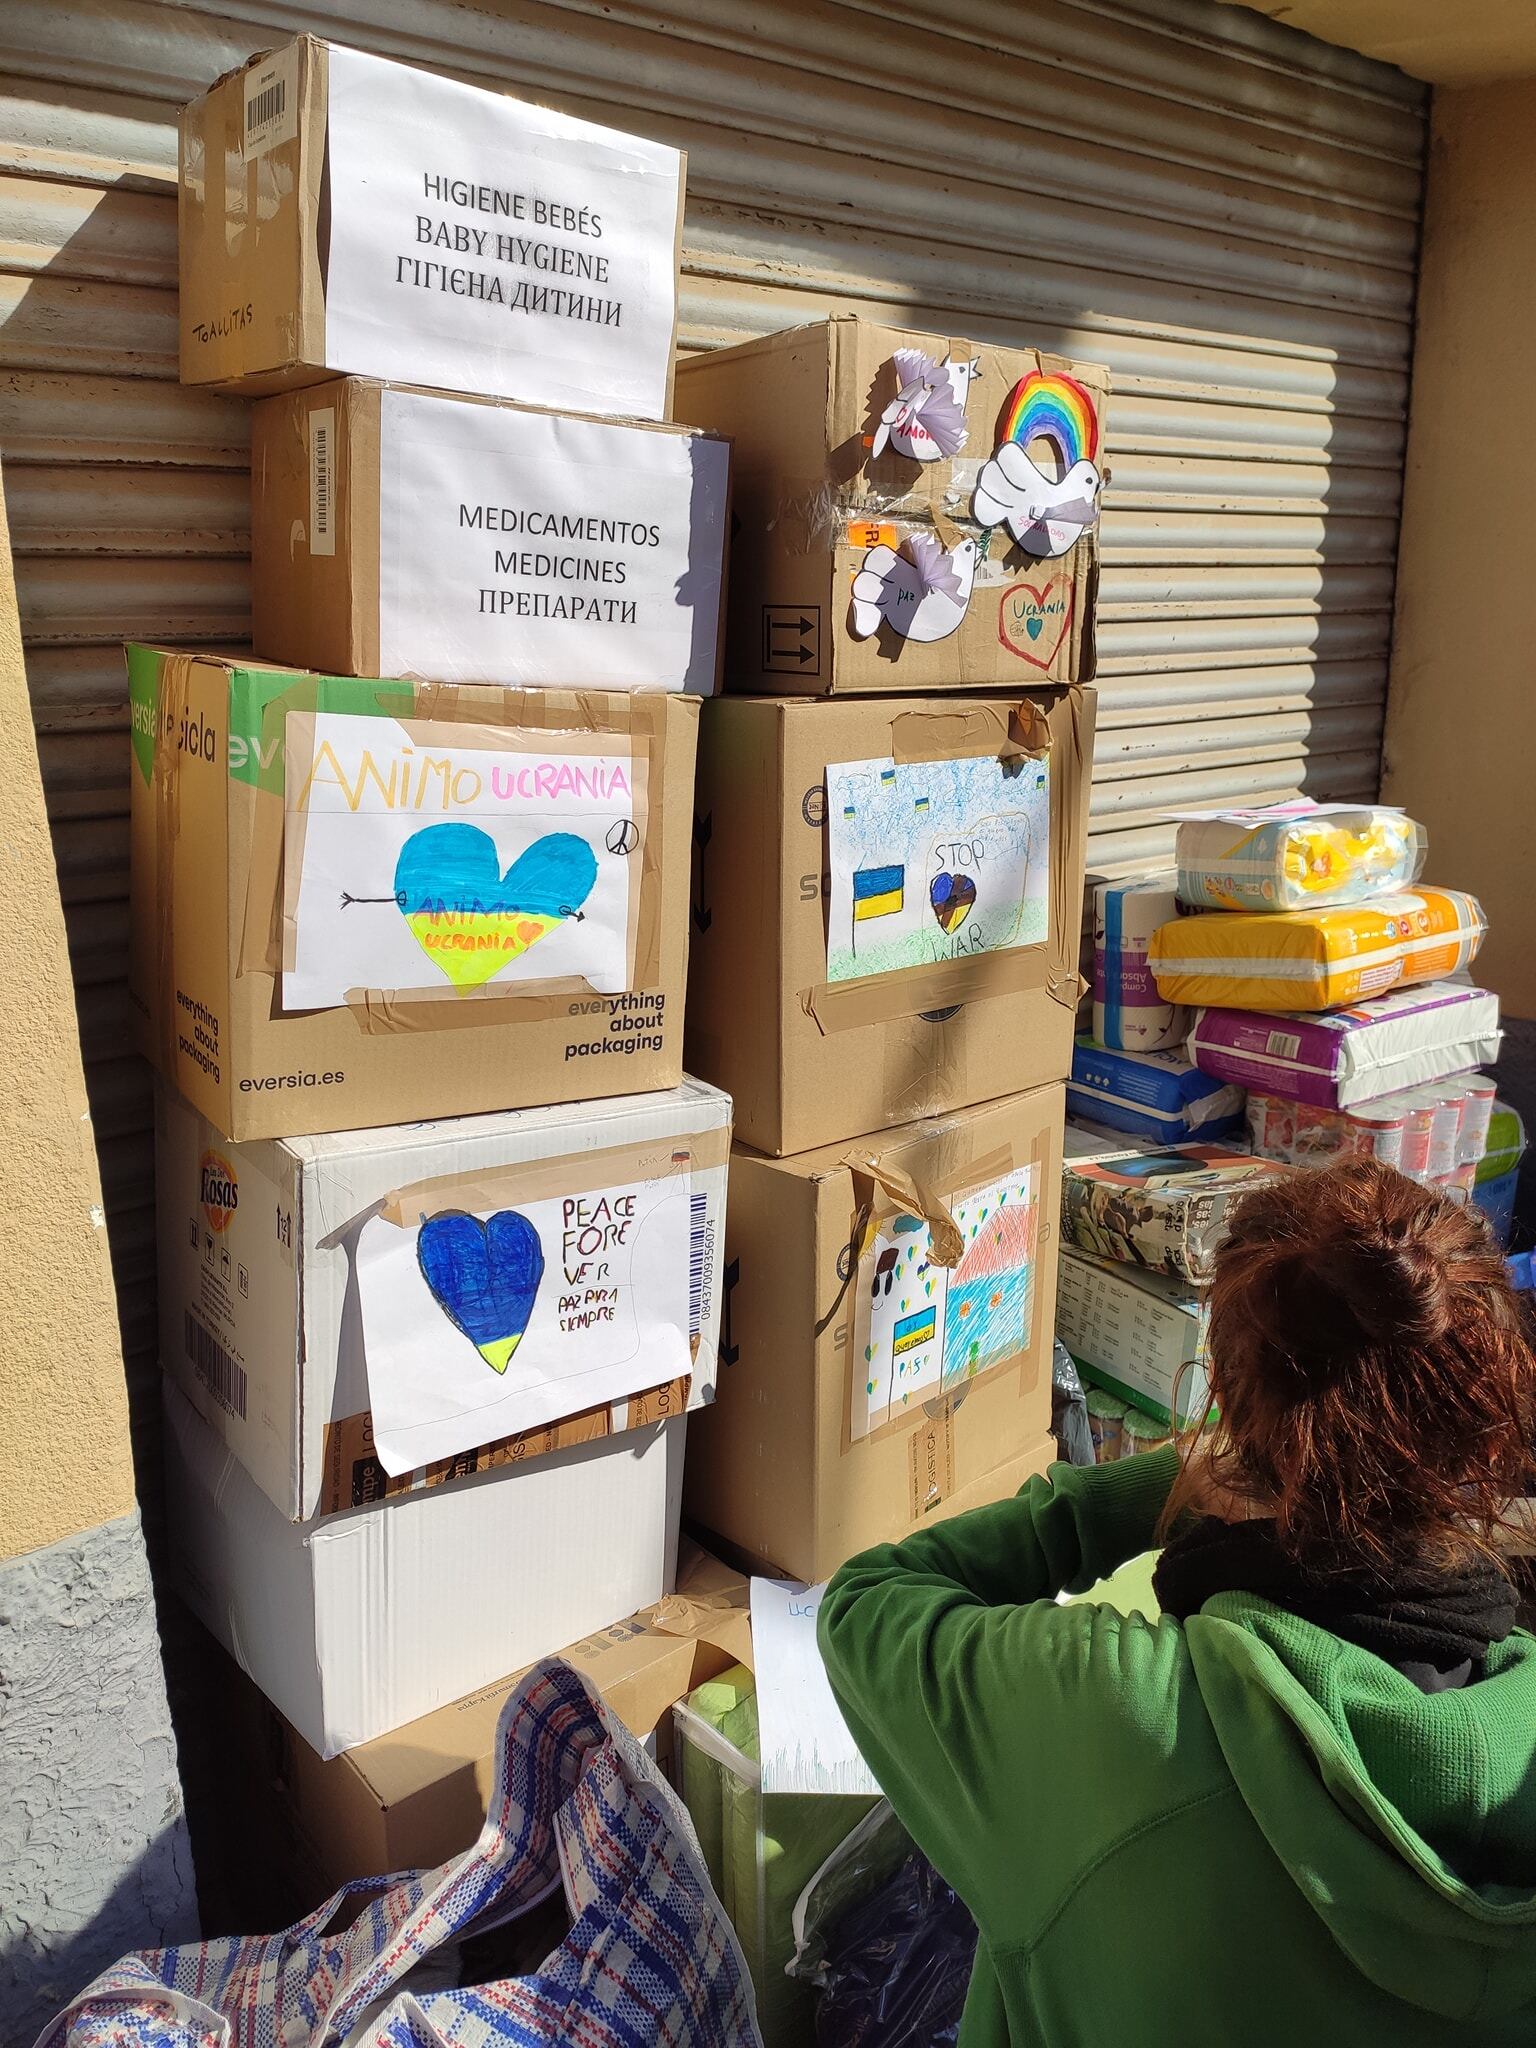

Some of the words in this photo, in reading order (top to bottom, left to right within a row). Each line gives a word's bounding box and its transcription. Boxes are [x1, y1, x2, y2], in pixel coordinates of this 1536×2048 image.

[424, 172, 525, 221] HIGIENE
[533, 205, 603, 239] BEBÉS
[415, 214, 489, 257] BABY
[496, 233, 610, 284] HYGIENE
[395, 254, 505, 305] ГІГІЄНА
[510, 280, 623, 328] ДИТИНИ
[459, 503, 661, 548] MEDICAMENTOS
[494, 550, 627, 584] MEDICINES
[478, 589, 638, 624] ПРЕПАРАТИ
[1013, 599, 1066, 619] UCRANIA
[934, 838, 985, 875] STOP
[176, 989, 219, 1037] everything
[568, 991, 665, 1016] everything
[609, 1012, 664, 1032] about
[194, 1023, 219, 1057] about
[564, 1033, 663, 1061] packaging
[178, 1034, 220, 1085] packaging
[239, 1070, 345, 1093] eversia.es
[200, 1167, 238, 1210] Rosas
[563, 1195, 636, 1229] PEACE
[563, 1221, 632, 1265] FORE
[701, 1219, 716, 1320] 08437009356074
